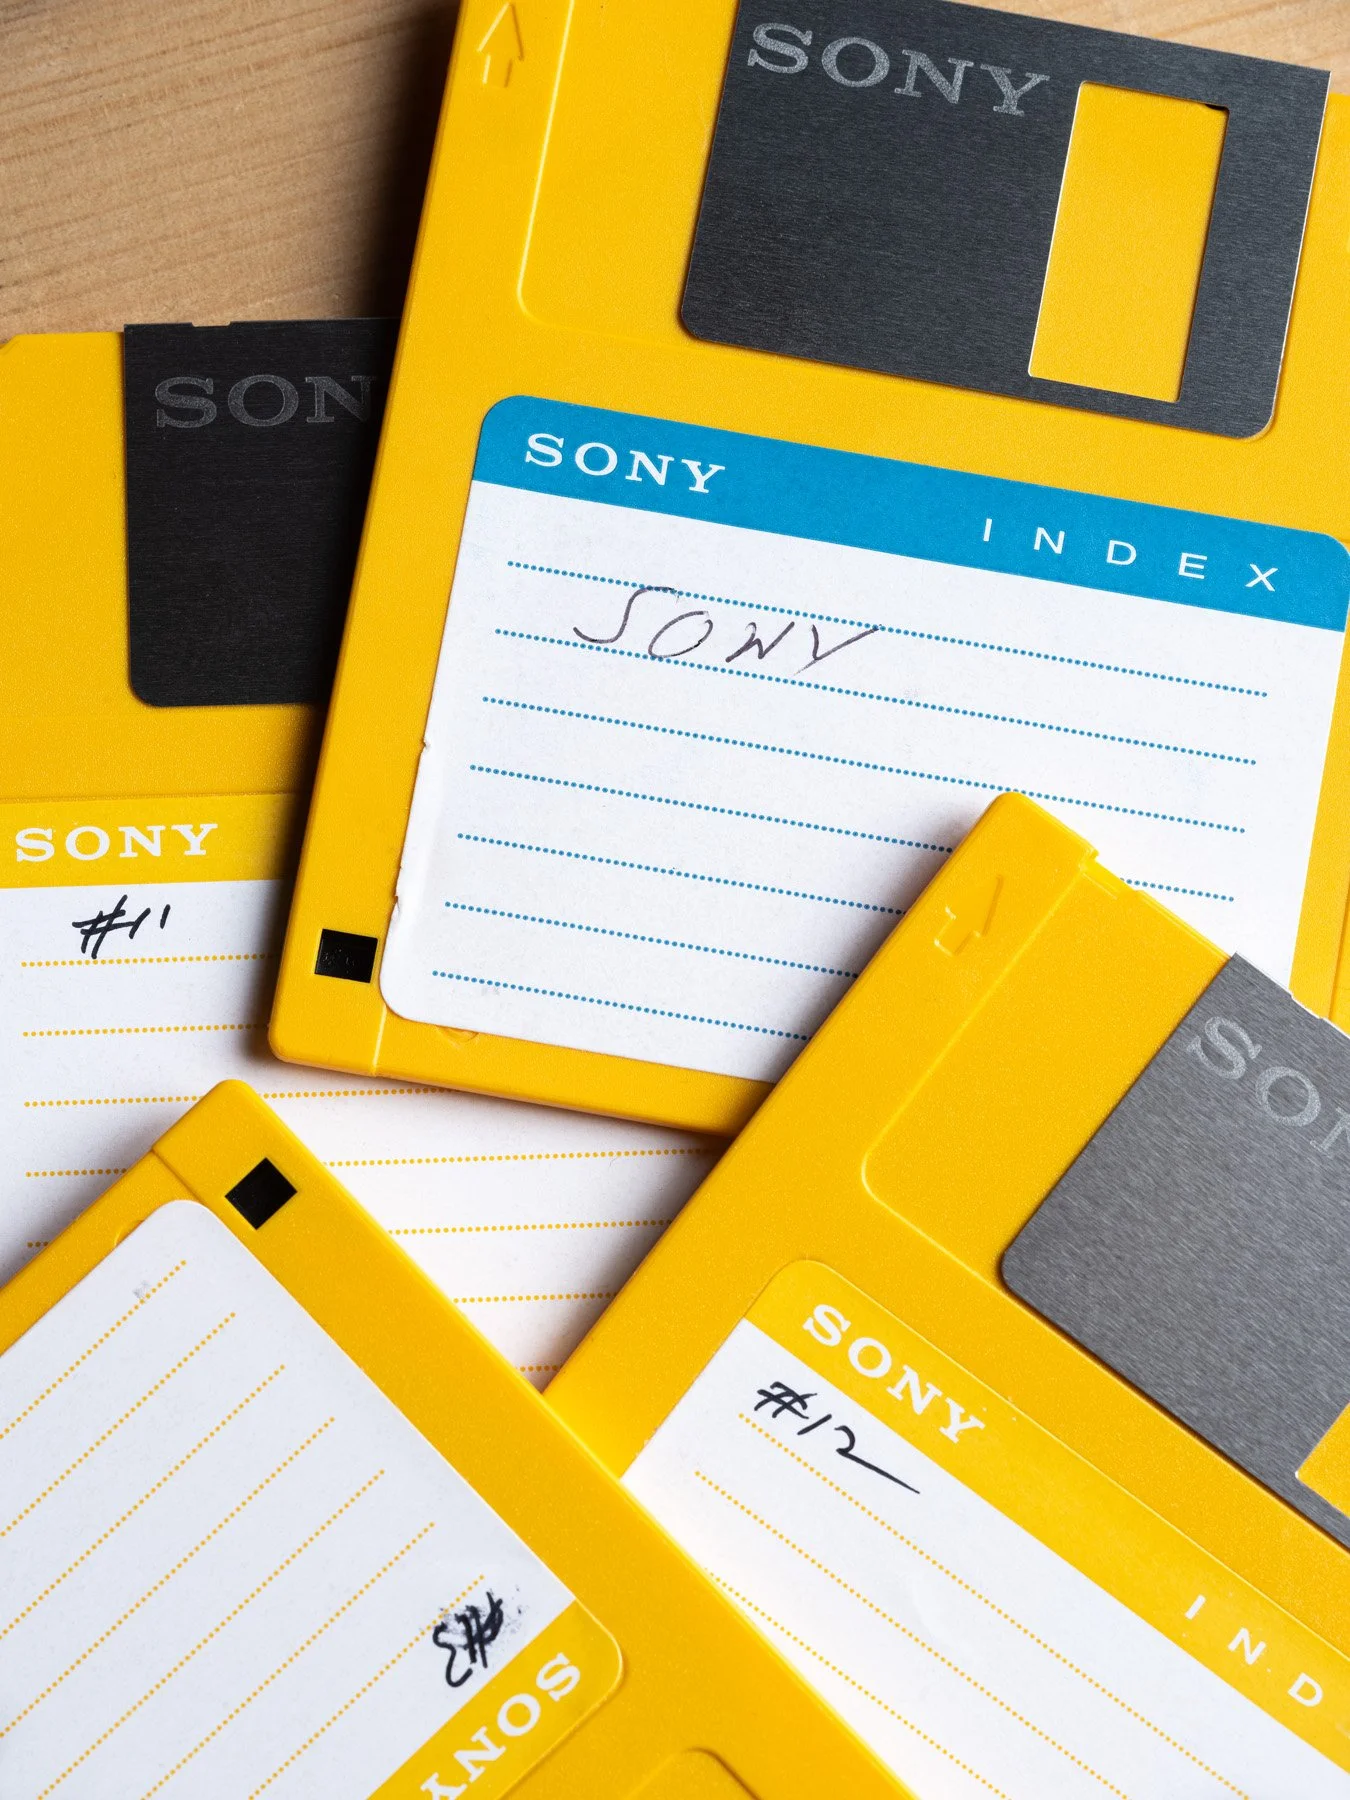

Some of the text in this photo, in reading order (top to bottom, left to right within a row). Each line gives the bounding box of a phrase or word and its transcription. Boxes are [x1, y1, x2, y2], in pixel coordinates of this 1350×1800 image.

[747, 22, 1050, 118] SONY
[525, 433, 726, 494] SONY
[983, 517, 1280, 593] INDEX
[15, 823, 218, 863] SONY
[802, 1303, 986, 1444] SONY
[754, 1381, 921, 1494] #12
